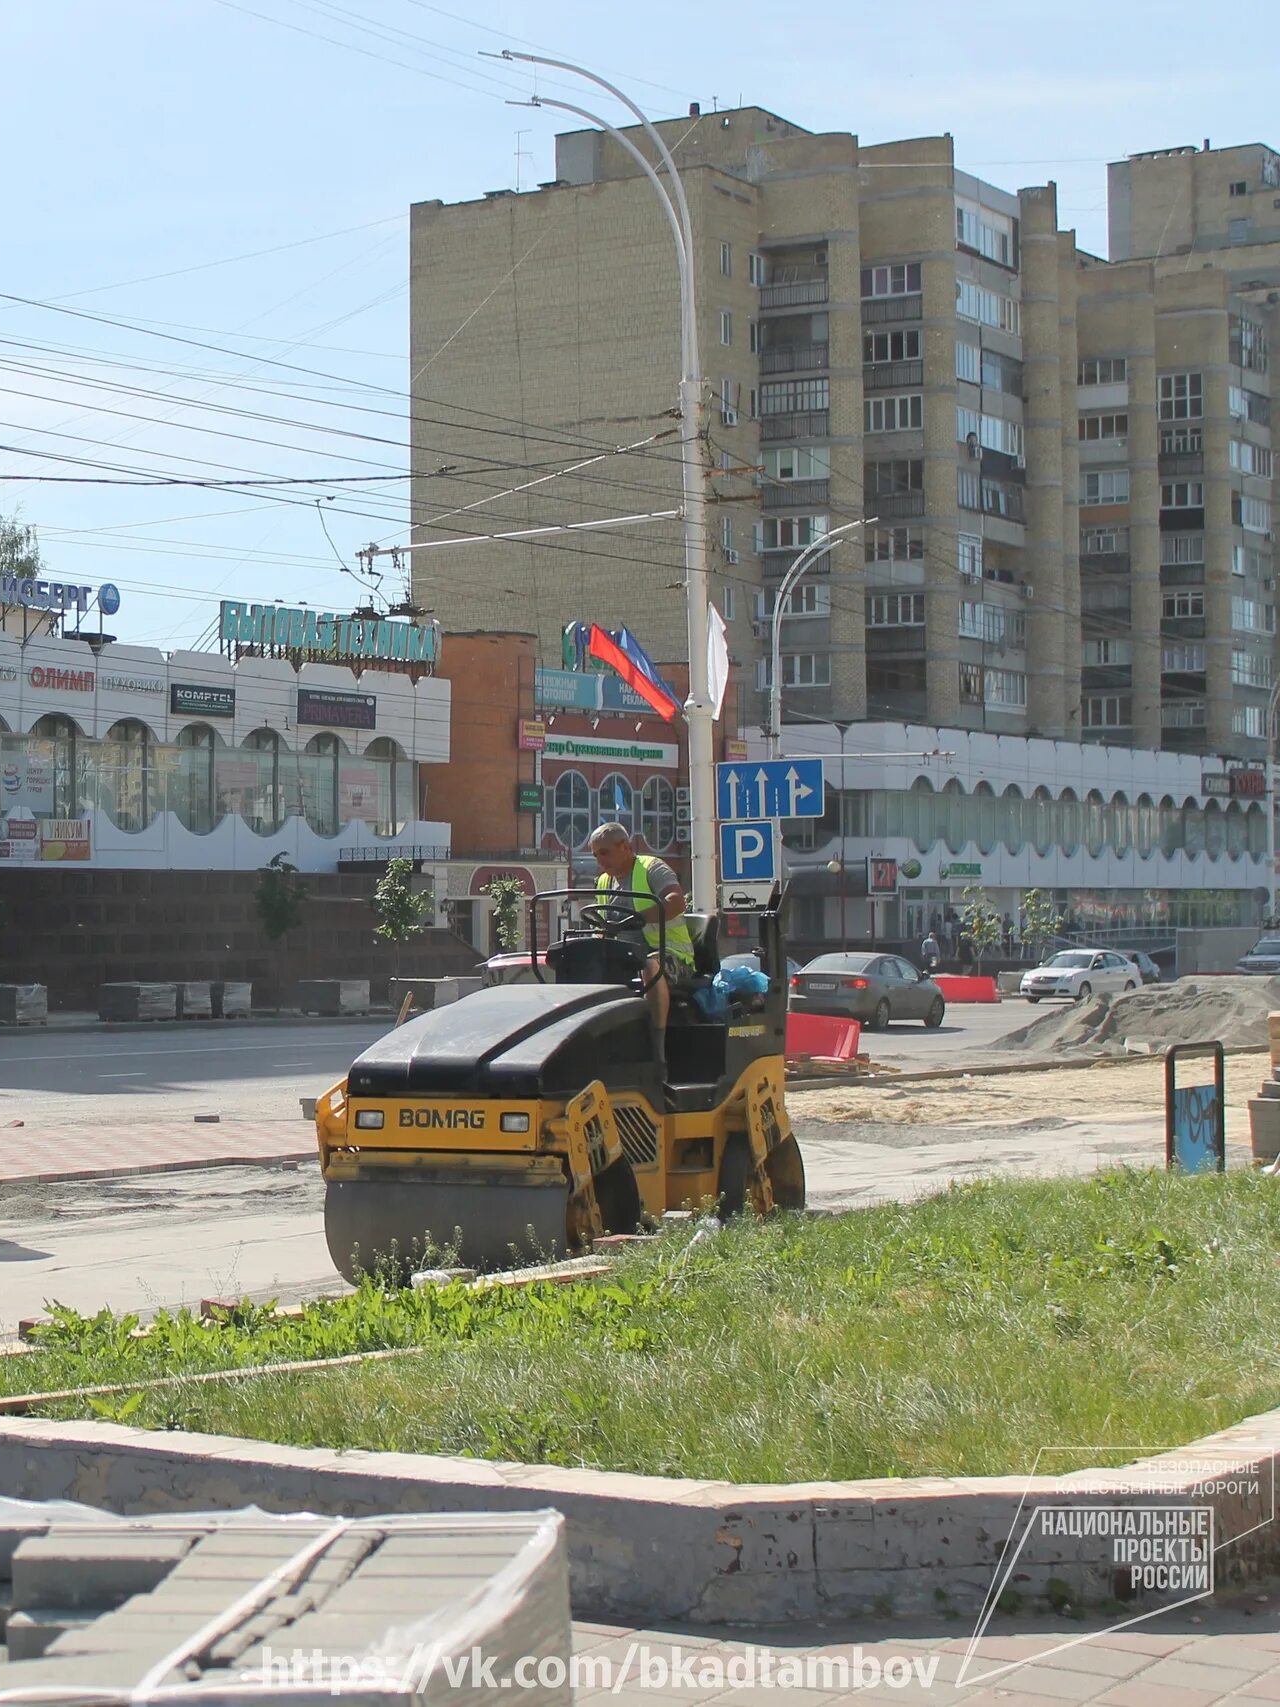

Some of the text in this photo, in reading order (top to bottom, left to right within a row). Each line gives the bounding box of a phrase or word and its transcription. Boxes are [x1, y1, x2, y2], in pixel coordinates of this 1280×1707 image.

[220, 600, 436, 661] БЫТОВАЯ ТЕХНИКА
[29, 666, 95, 692] ОЛИМП
[102, 675, 165, 693] ПУХОВИКИ
[176, 689, 234, 703] KOMPTEL
[304, 702, 370, 725] PRIMAVERA
[566, 741, 622, 757] Страхования
[49, 821, 83, 839] УНИКУМ
[735, 829, 764, 874] P
[399, 1109, 485, 1129] BOMAG
